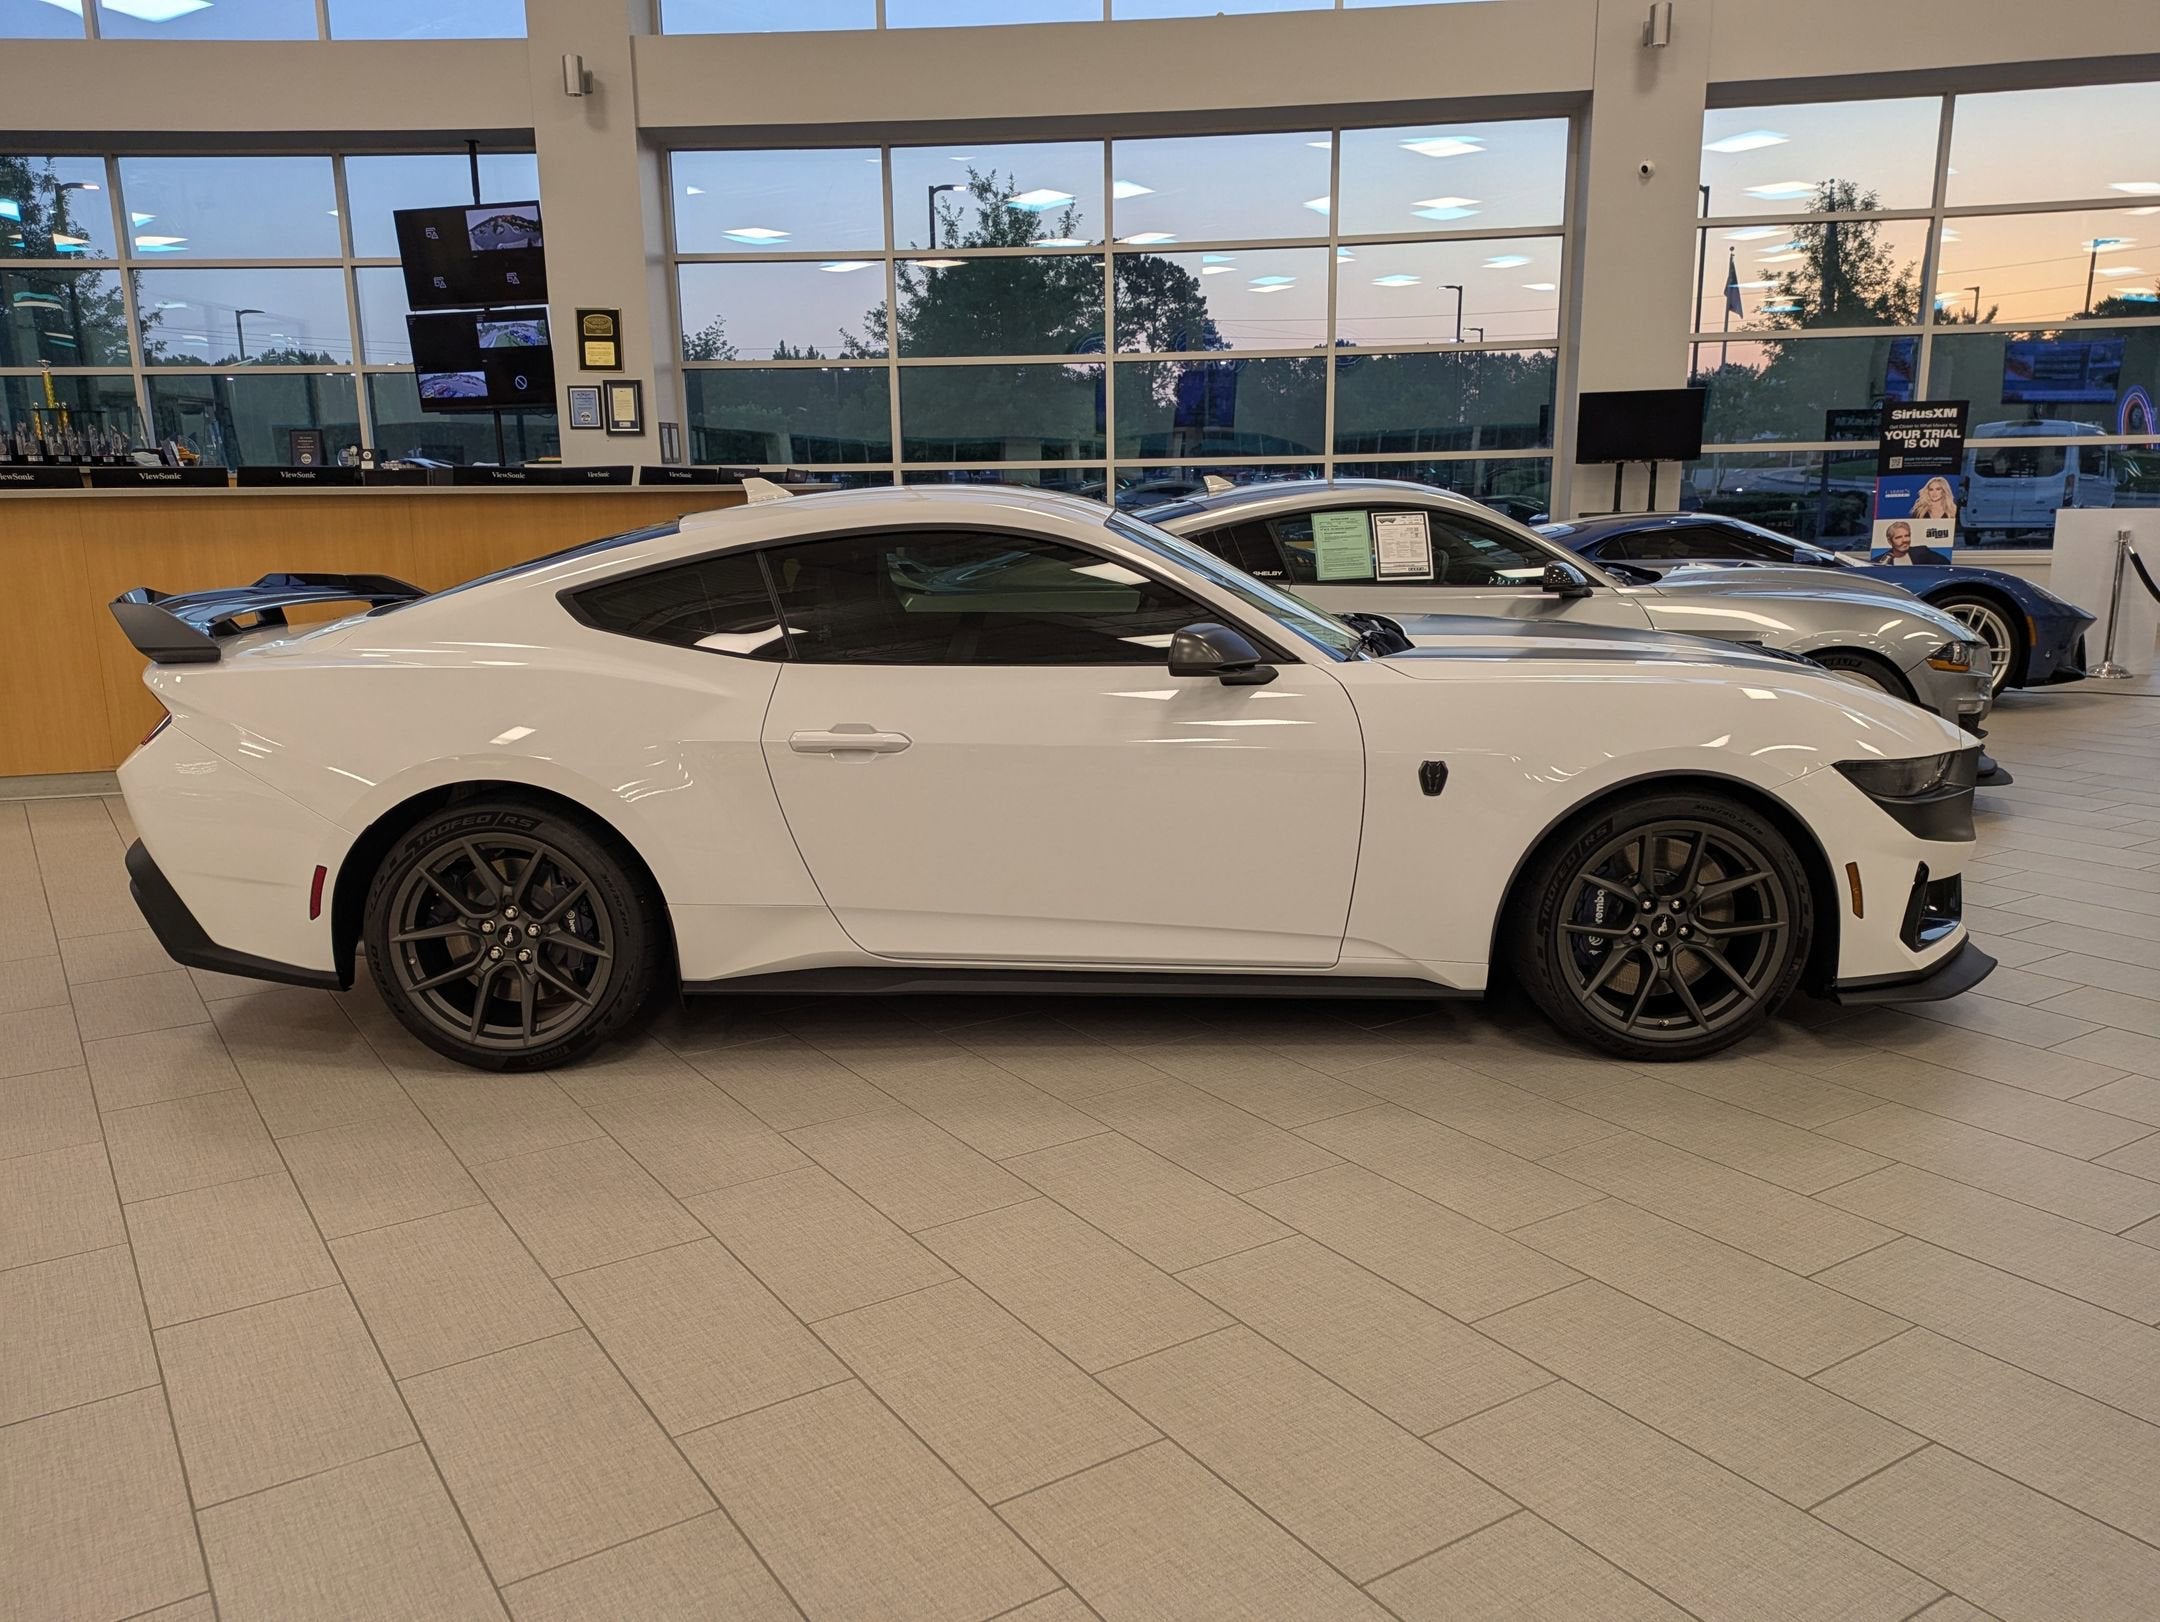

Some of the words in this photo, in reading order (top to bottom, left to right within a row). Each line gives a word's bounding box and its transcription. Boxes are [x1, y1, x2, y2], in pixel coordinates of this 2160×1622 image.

[1891, 408, 1958, 420] SiriusXM
[1884, 430, 1921, 440] YOUR
[1923, 429, 1961, 439] TRIAL
[1904, 439, 1917, 448] IS
[1919, 439, 1940, 448] ON
[139, 472, 182, 480] ViewSonic
[280, 471, 316, 479] ViewSonic
[492, 471, 526, 479] ViewSonic
[416, 814, 494, 845] TROFEO
[503, 815, 535, 828] RS
[1541, 851, 1577, 920] TROFEO
[1584, 824, 1608, 847] RS
[1594, 889, 1606, 924] rembo
